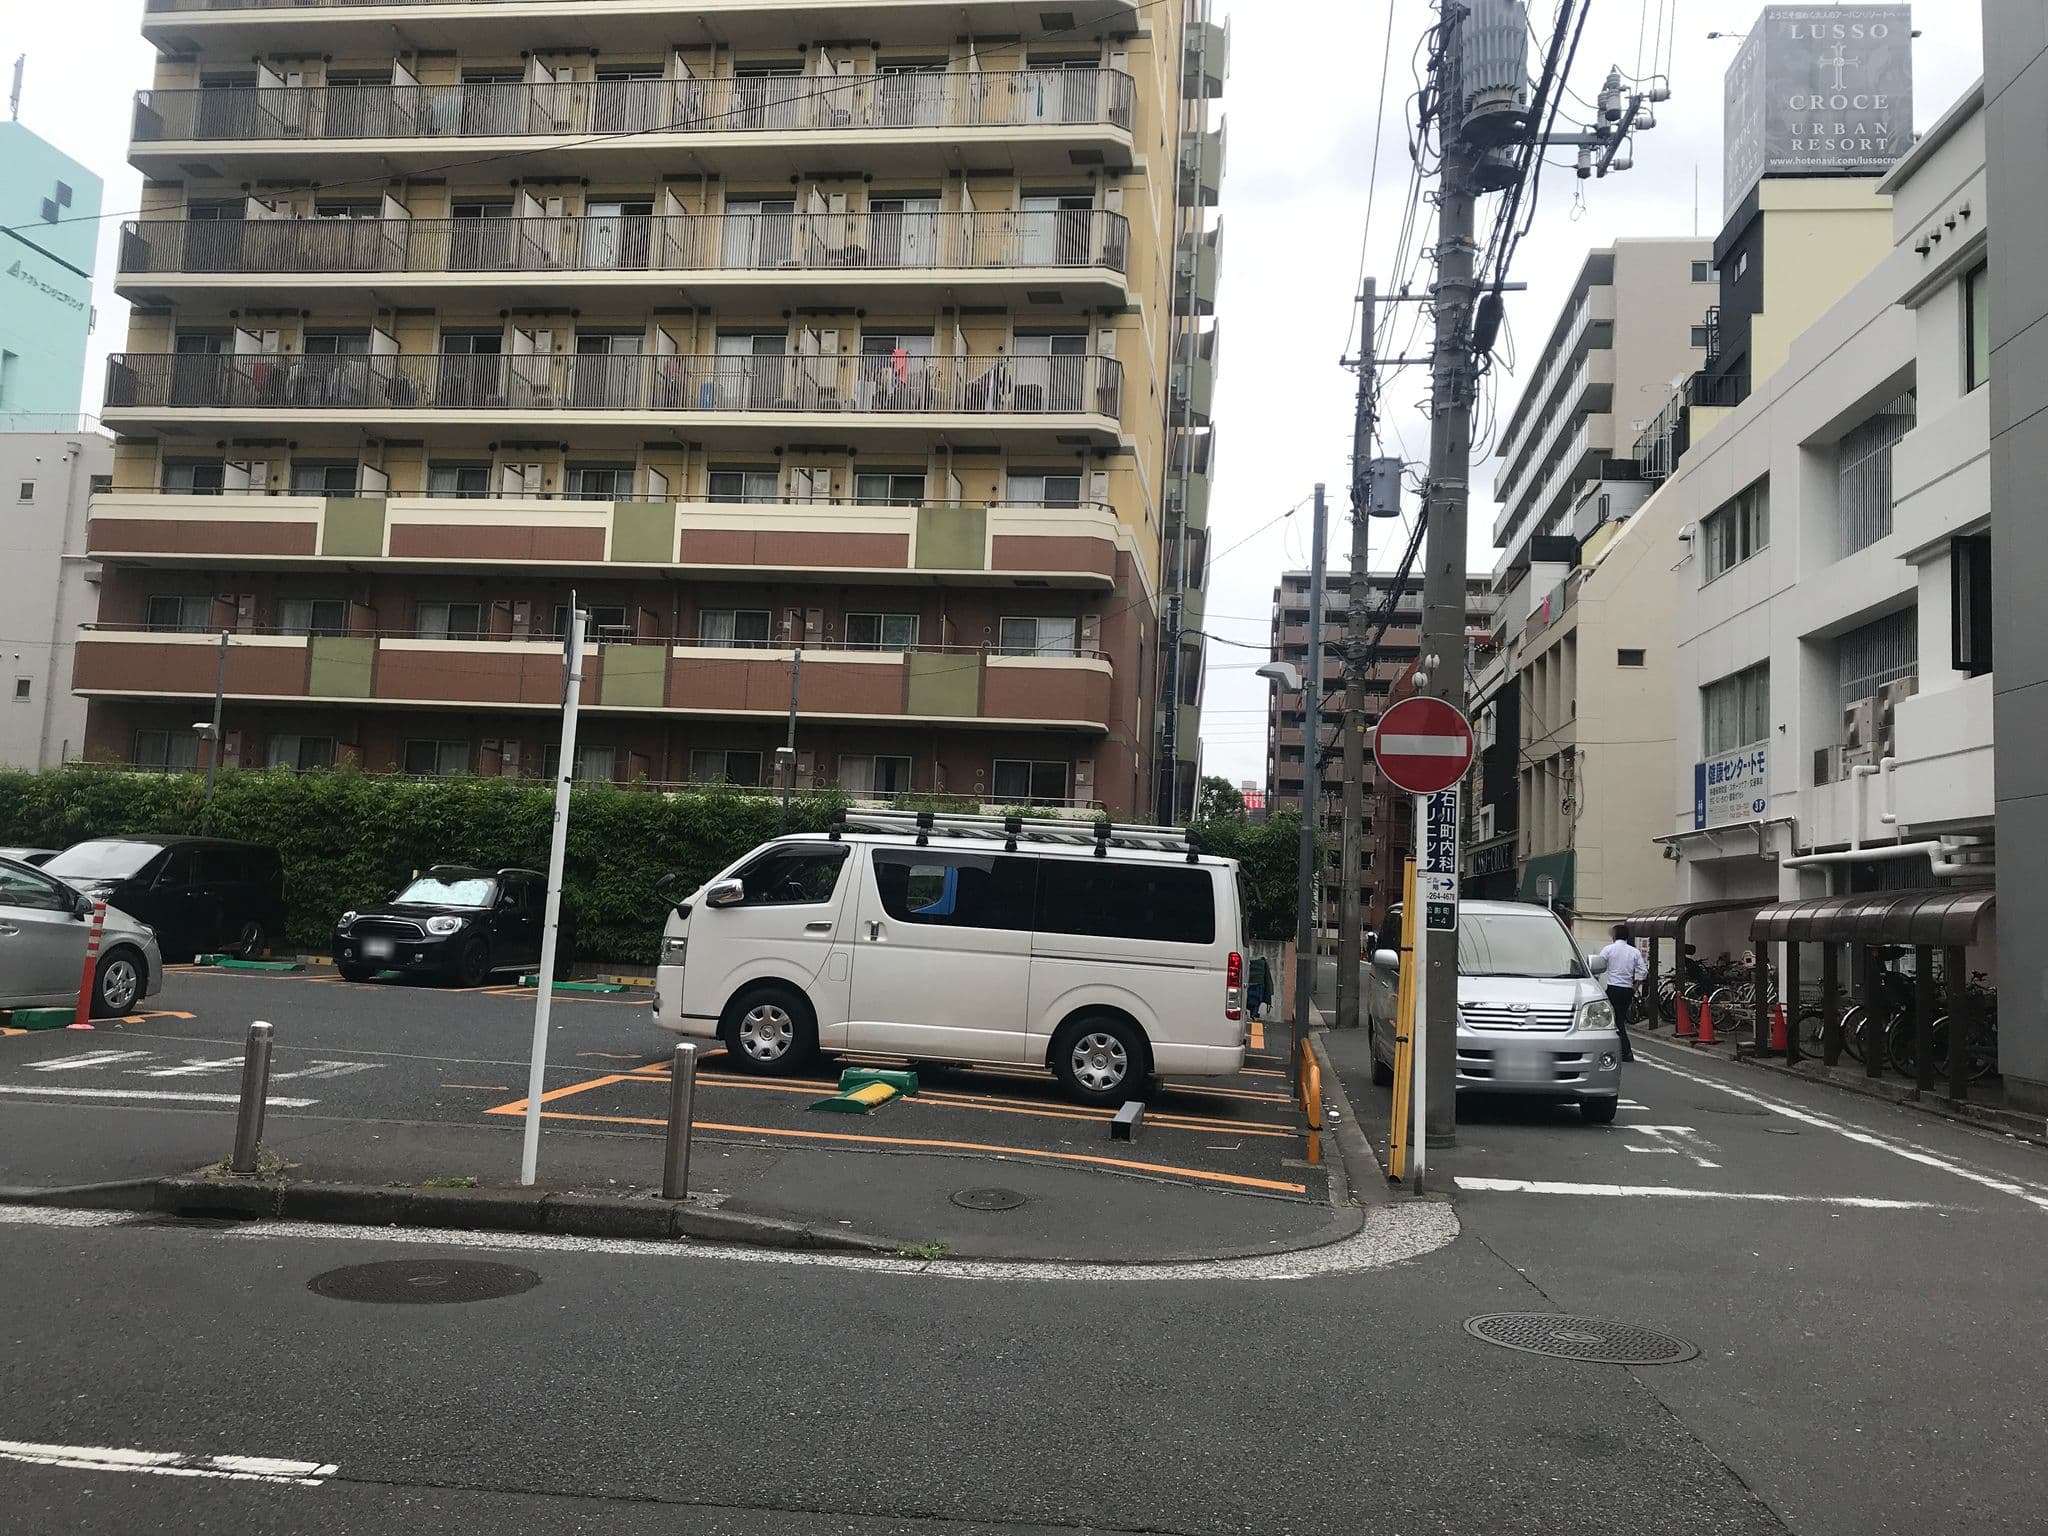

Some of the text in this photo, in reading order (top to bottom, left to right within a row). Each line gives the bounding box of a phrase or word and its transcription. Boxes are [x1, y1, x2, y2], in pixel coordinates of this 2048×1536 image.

[1791, 24, 1889, 39] LUSSO
[1789, 95, 1889, 110] CROCE
[1791, 123, 1889, 135] URBAN
[1791, 138, 1889, 151] RESORT
[1439, 791, 1455, 872] 石川町内科
